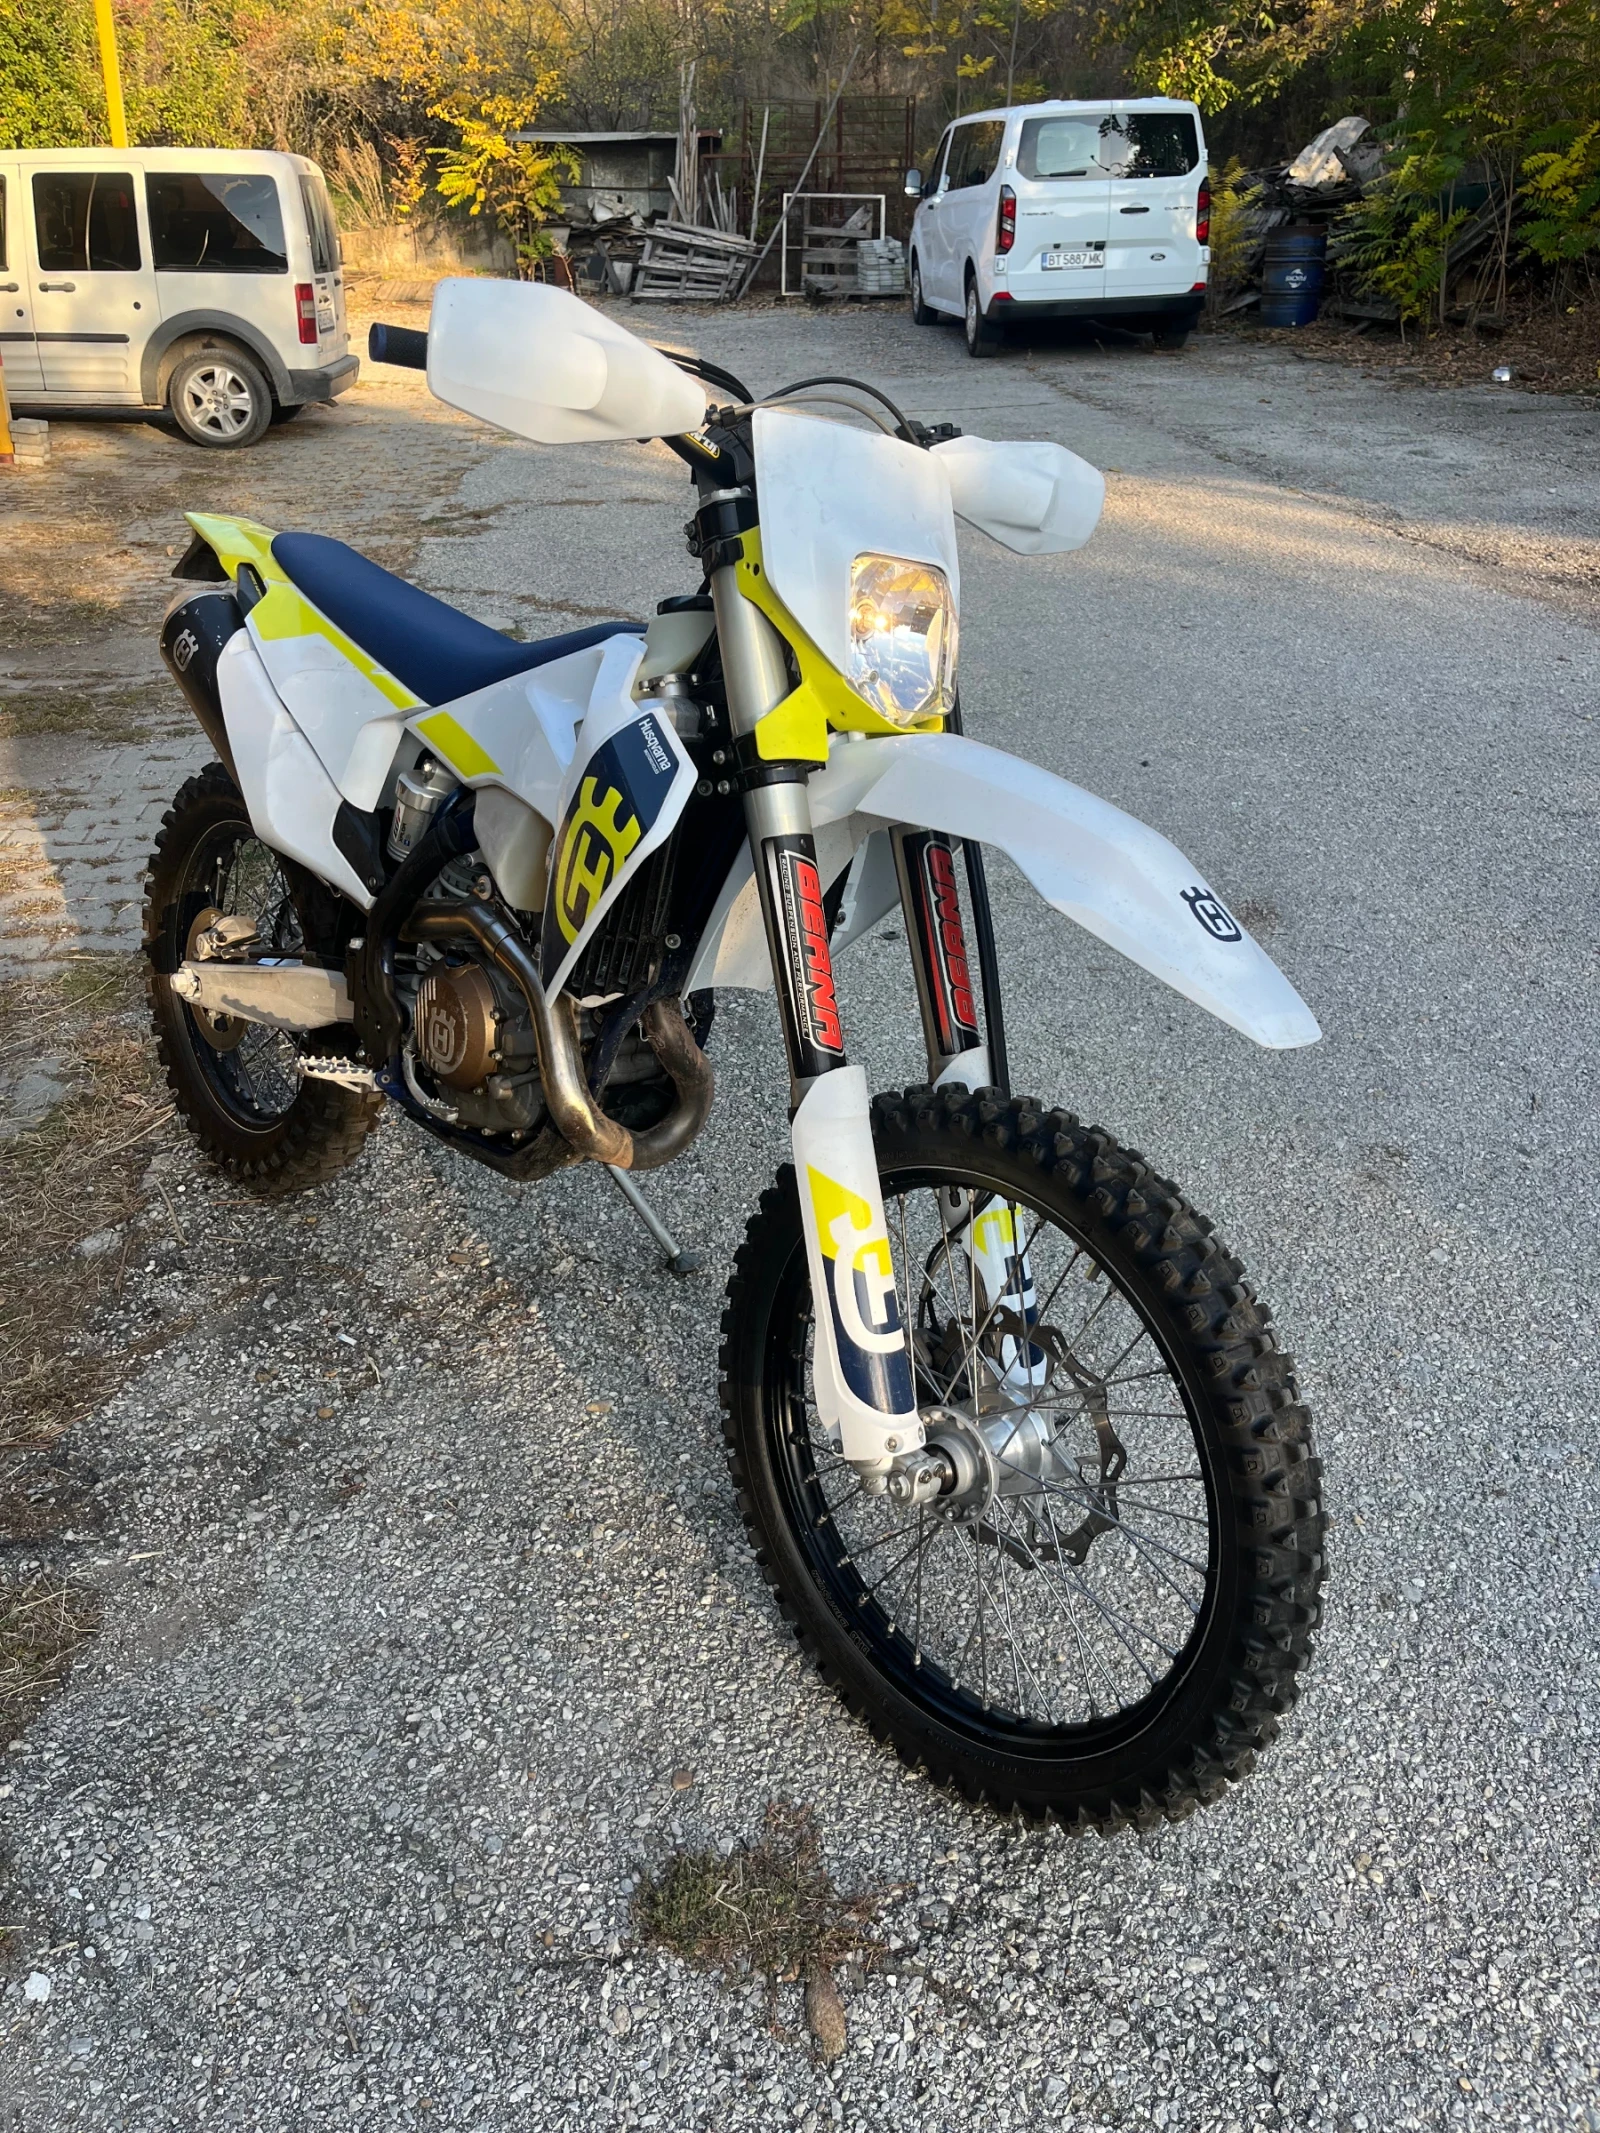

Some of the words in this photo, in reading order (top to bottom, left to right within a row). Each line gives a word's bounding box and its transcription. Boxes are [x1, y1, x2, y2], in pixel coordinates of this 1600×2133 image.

[1048, 254, 1061, 266] BT
[1063, 252, 1087, 265] 5887
[1088, 252, 1102, 264] MK
[638, 717, 672, 771] Husqvarna
[785, 891, 797, 948] SUSPENSION
[796, 970, 809, 1034] PERFORMANCE
[796, 859, 844, 1051] BERNA
[930, 847, 978, 1028] BERNA
